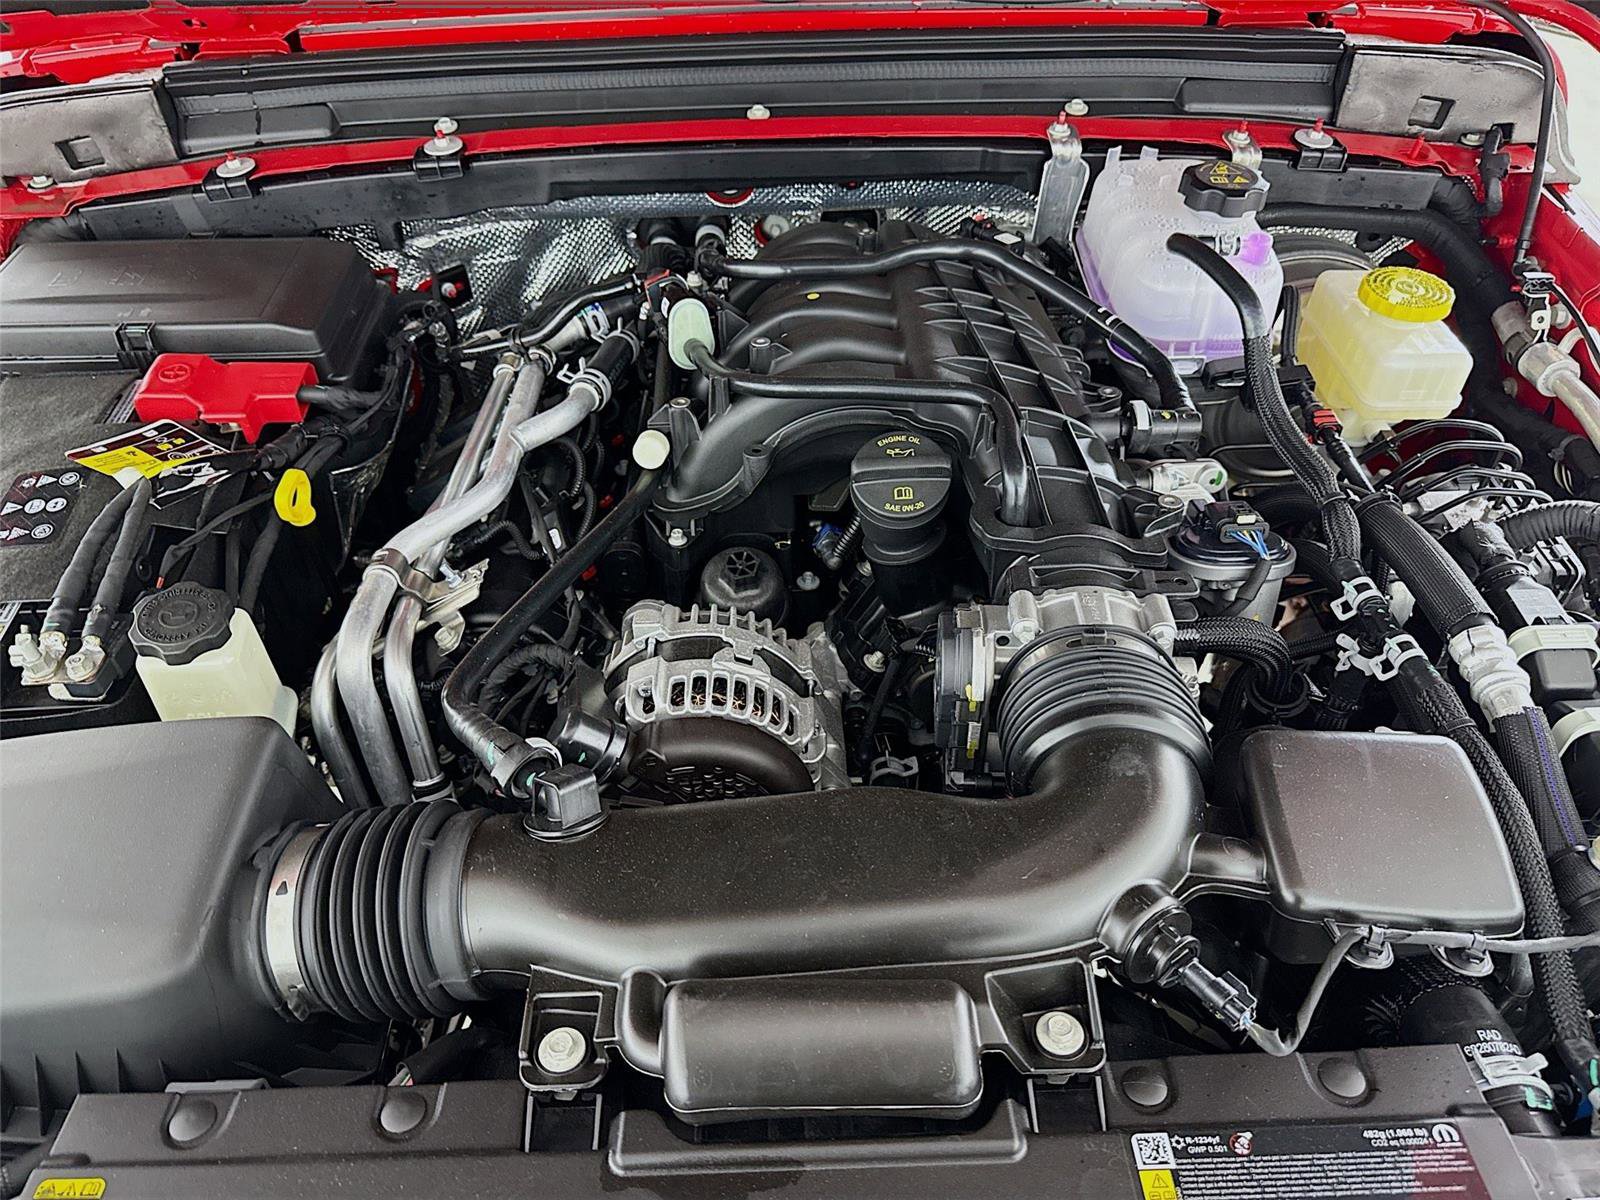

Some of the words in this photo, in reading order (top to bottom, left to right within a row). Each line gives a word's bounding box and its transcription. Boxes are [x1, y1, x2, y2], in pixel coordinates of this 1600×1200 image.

[877, 435, 907, 447] ENGINE
[908, 436, 921, 445] OIL
[884, 502, 901, 512] SAE
[902, 501, 925, 512] 0W-20
[1476, 1029, 1502, 1041] RAD
[1185, 1136, 1220, 1145] R-1234yf
[1187, 1146, 1207, 1154] GWP
[1207, 1145, 1228, 1153] 0.501
